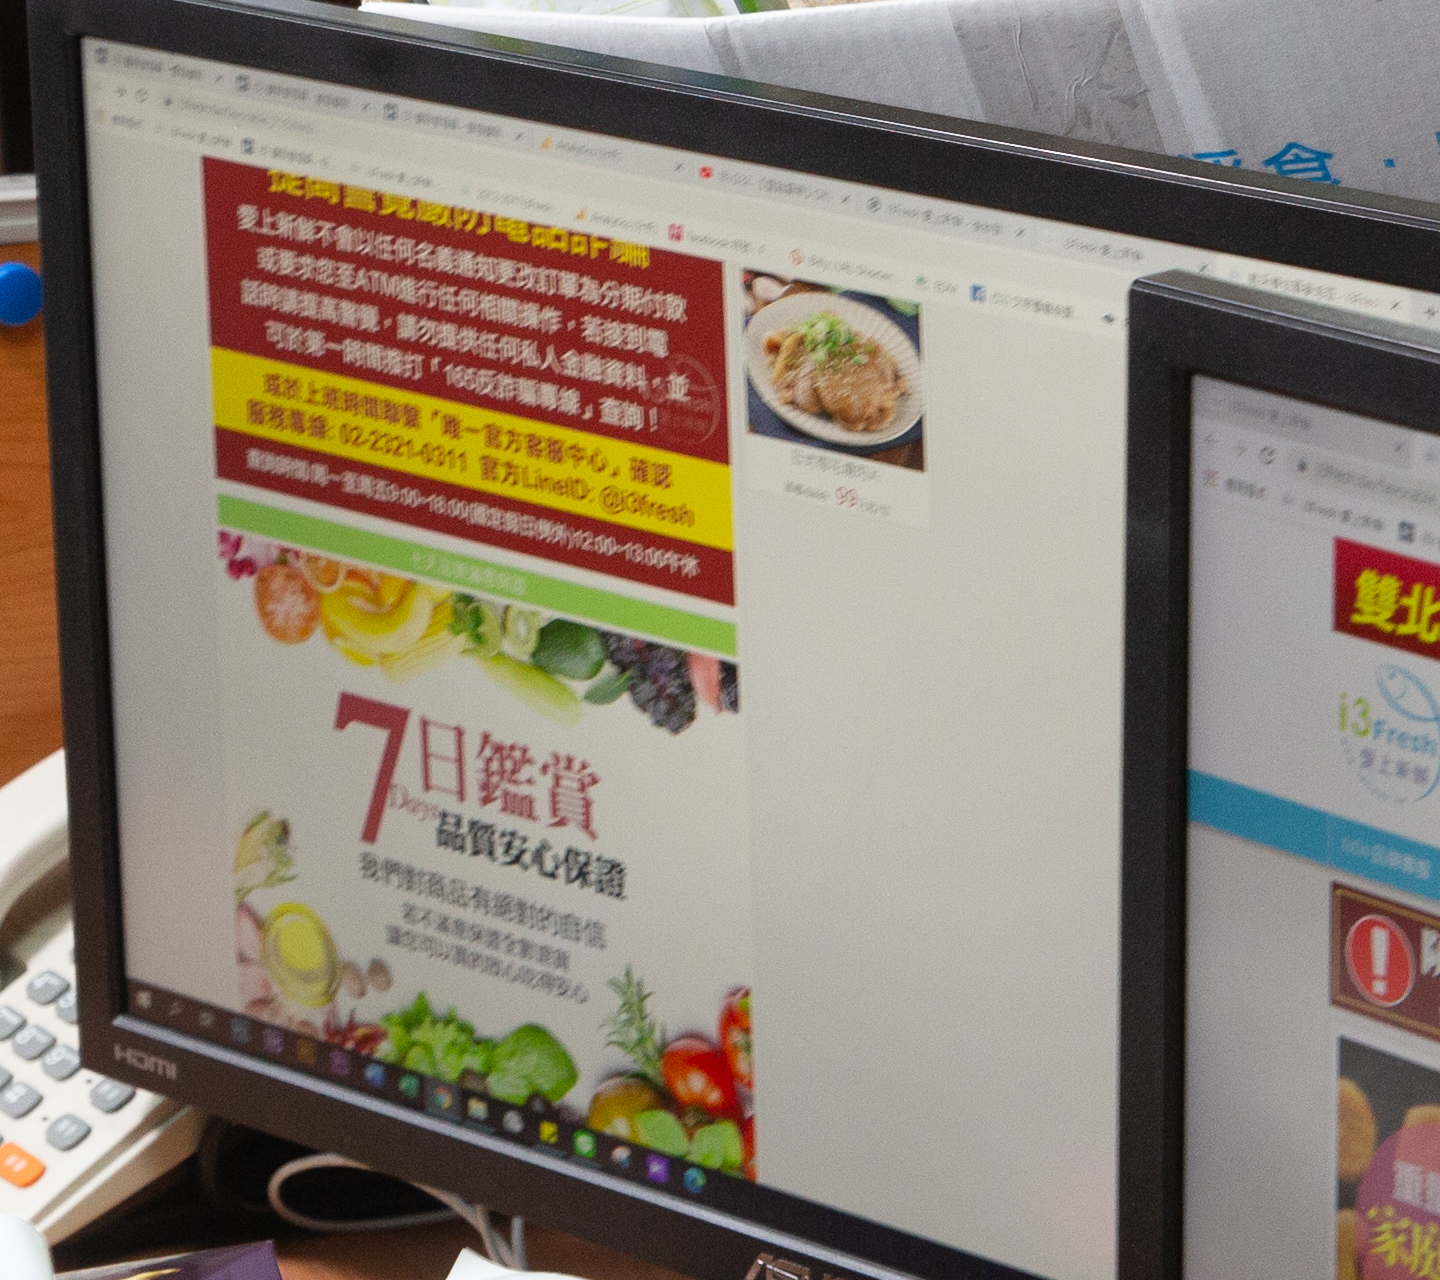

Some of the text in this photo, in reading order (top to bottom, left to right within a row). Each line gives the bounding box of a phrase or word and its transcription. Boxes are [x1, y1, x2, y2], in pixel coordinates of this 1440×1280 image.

[338, 421, 469, 474] 02-2321-0311
[1338, 690, 1438, 757] i3Fresh
[435, 807, 628, 902] 品質安心保證
[113, 1043, 178, 1081] HDMI
